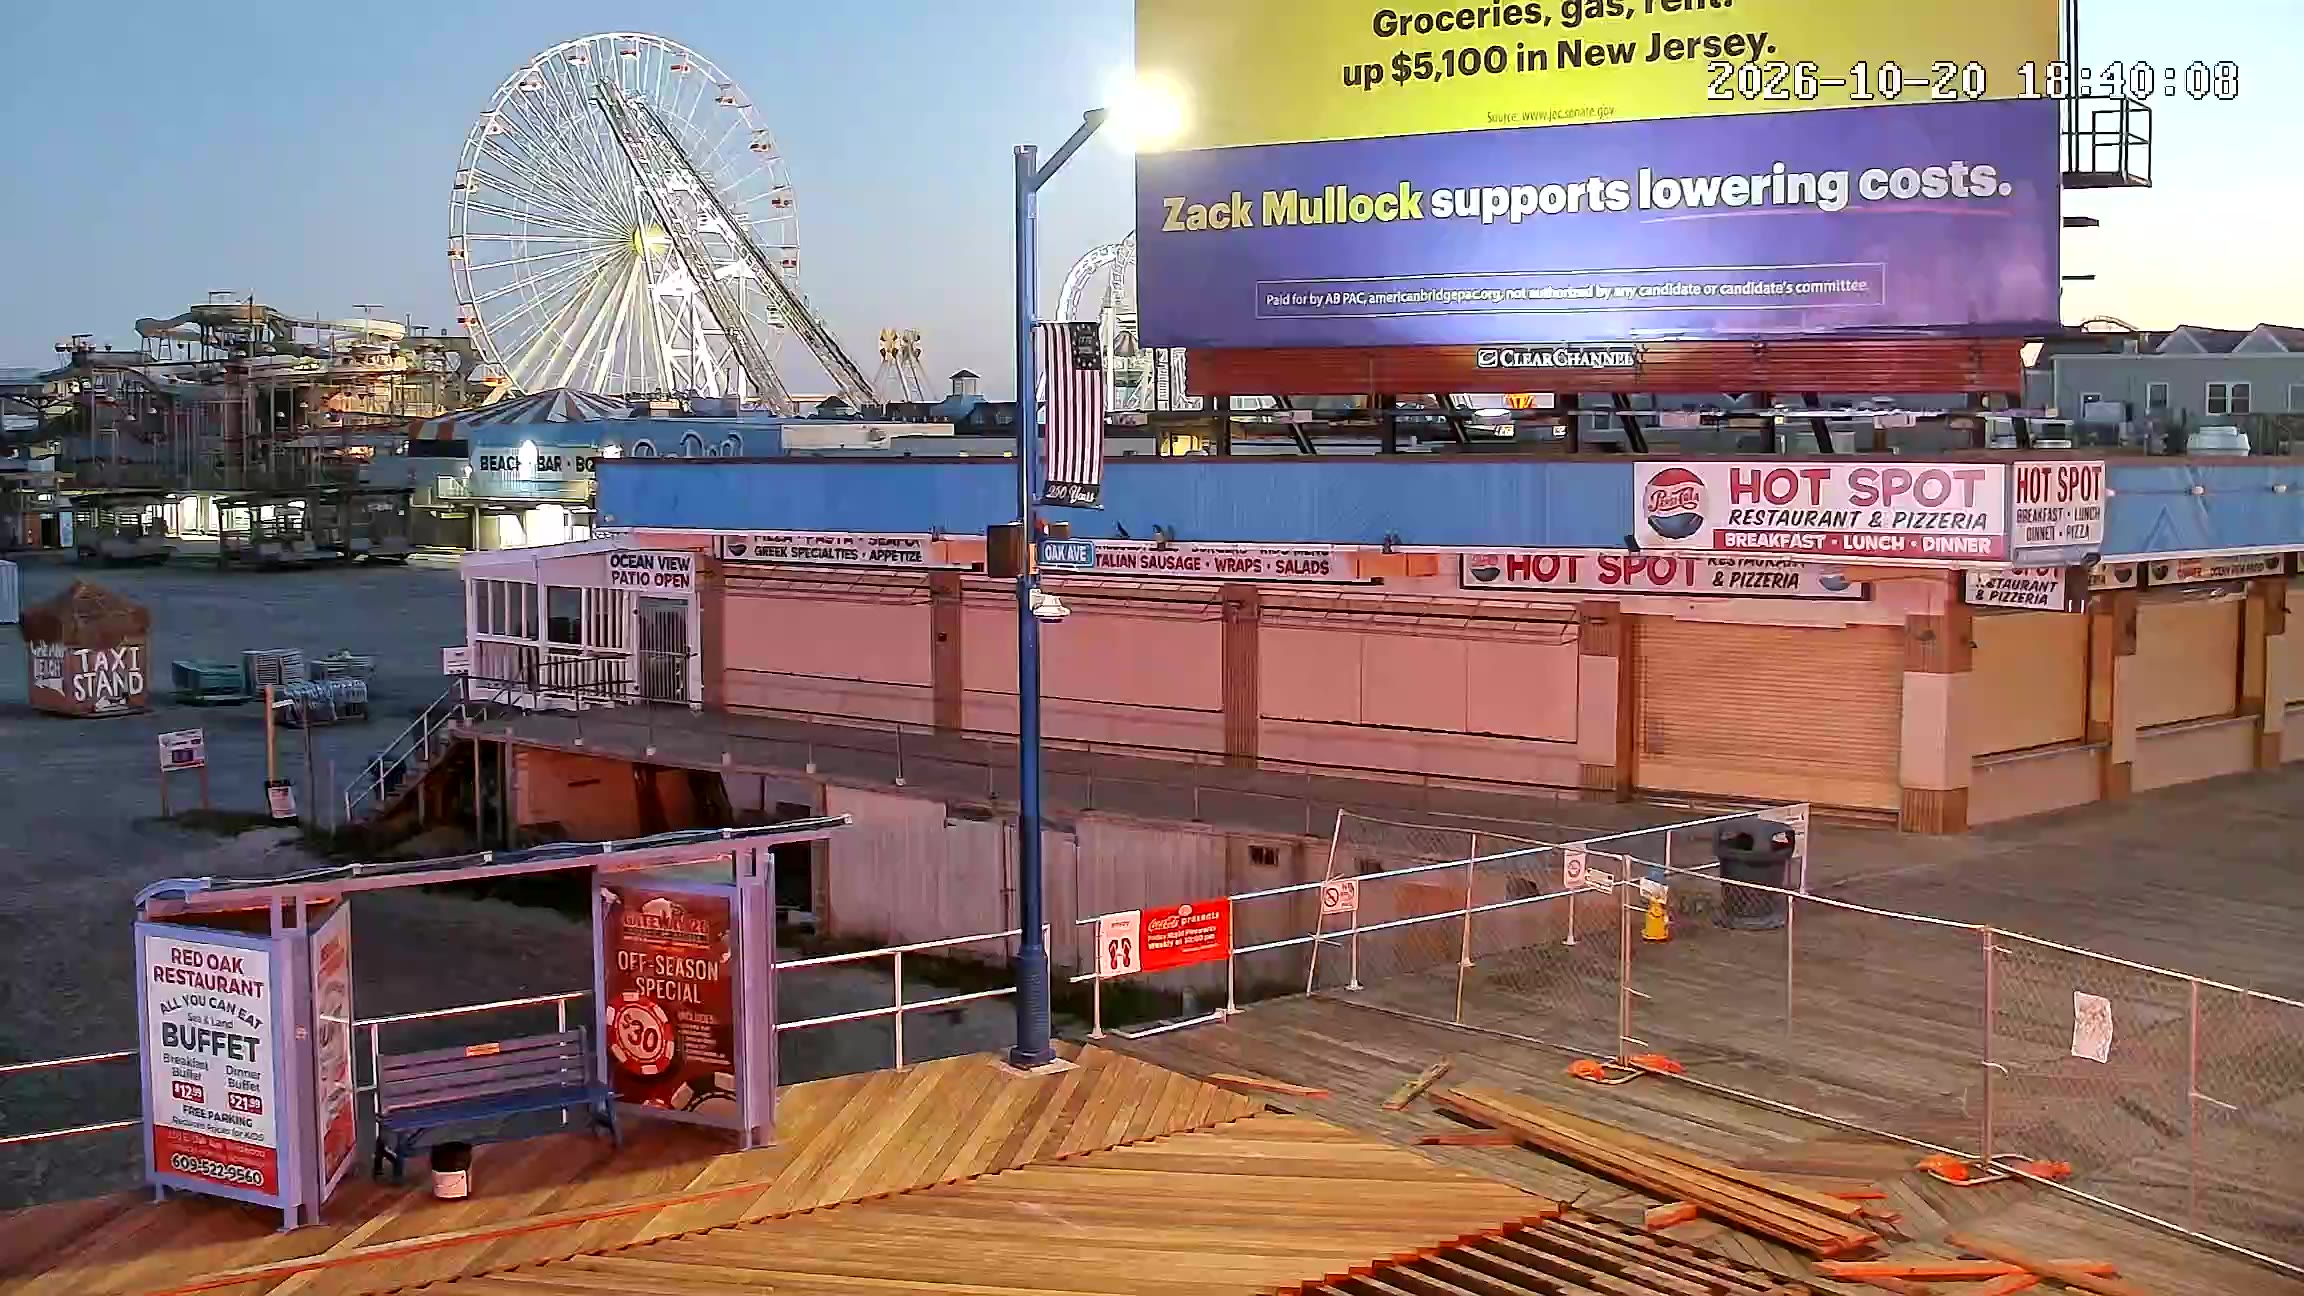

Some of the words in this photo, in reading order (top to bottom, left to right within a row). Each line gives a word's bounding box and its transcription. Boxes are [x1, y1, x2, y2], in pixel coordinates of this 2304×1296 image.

[1373, 0, 1552, 37] Groceries,
[1560, 0, 1635, 28] gas,
[1343, 62, 1384, 91] up
[1391, 45, 1508, 87] $5,100
[1517, 42, 1548, 73] in
[1557, 39, 1637, 70] New
[1645, 31, 1777, 62] Jersey.
[1162, 190, 1255, 232] Zack
[1262, 180, 1425, 229] Mullock
[1430, 175, 1632, 225] supports
[1638, 161, 1850, 213] lowering
[1859, 160, 2013, 200] costs.
[1266, 293, 1290, 306] Paid
[1292, 292, 1307, 305] for
[1310, 292, 1324, 308] by
[1326, 293, 1341, 305] AB
[1343, 291, 1367, 306] PAC,
[1506, 287, 1527, 300] not
[1596, 284, 1611, 301] by
[1640, 281, 1701, 297] candidate
[1704, 284, 1718, 296] or
[1720, 280, 1793, 295] candidate's
[537, 455, 562, 472] BAR
[1729, 467, 1831, 507] HOT
[1848, 467, 1986, 507] SPOT
[2016, 466, 2052, 504] HOT
[2057, 466, 2102, 503] SPOT
[1728, 508, 1862, 528] RESTAURANT
[1868, 510, 1882, 528] &
[1891, 512, 1988, 531] PIZZERIA
[2017, 507, 2064, 523] BREAKFAST
[2074, 506, 2100, 522] LUNCH
[754, 545, 788, 558] GREEK
[791, 546, 858, 561] SPECIALTIES
[869, 549, 922, 563] APPETIZE
[1044, 543, 1067, 562] OAK
[1069, 544, 1088, 562] AVE
[1724, 532, 1827, 550] BREAKFAST
[1843, 534, 1905, 552] LUNCH
[1922, 536, 1992, 554] DINNER
[611, 553, 654, 570] OCEAN
[658, 555, 691, 571] VIEW
[1096, 552, 1137, 569] TALIAN
[1140, 552, 1201, 571] SAUSAGE
[1214, 557, 1262, 573] WRAPS
[1275, 559, 1329, 576] SALADS
[1506, 554, 1586, 584] HOT
[611, 570, 650, 586] PATIO
[654, 572, 690, 588] OPEN
[1712, 571, 1724, 587] &
[1729, 571, 1799, 589] PIZZERIA
[1989, 590, 2049, 606] PIZZERIA
[72, 646, 140, 673] TAXI
[73, 669, 144, 701] STAND
[171, 947, 203, 968] RED
[206, 953, 244, 975] OAK
[617, 949, 720, 981] OFF-SEASON
[153, 965, 265, 998] RESTAURANT
[635, 975, 702, 1005] SPECIAL
[160, 997, 182, 1015] ALL
[182, 994, 206, 1007] YOU
[208, 996, 236, 1015] CAN
[237, 1007, 264, 1029] EAT
[162, 1021, 261, 1063] BUFFET
[621, 1012, 659, 1054] $30
[182, 1104, 206, 1119] FREE
[208, 1110, 253, 1128] PARKING
[171, 1153, 264, 1187] 609-522-9560
